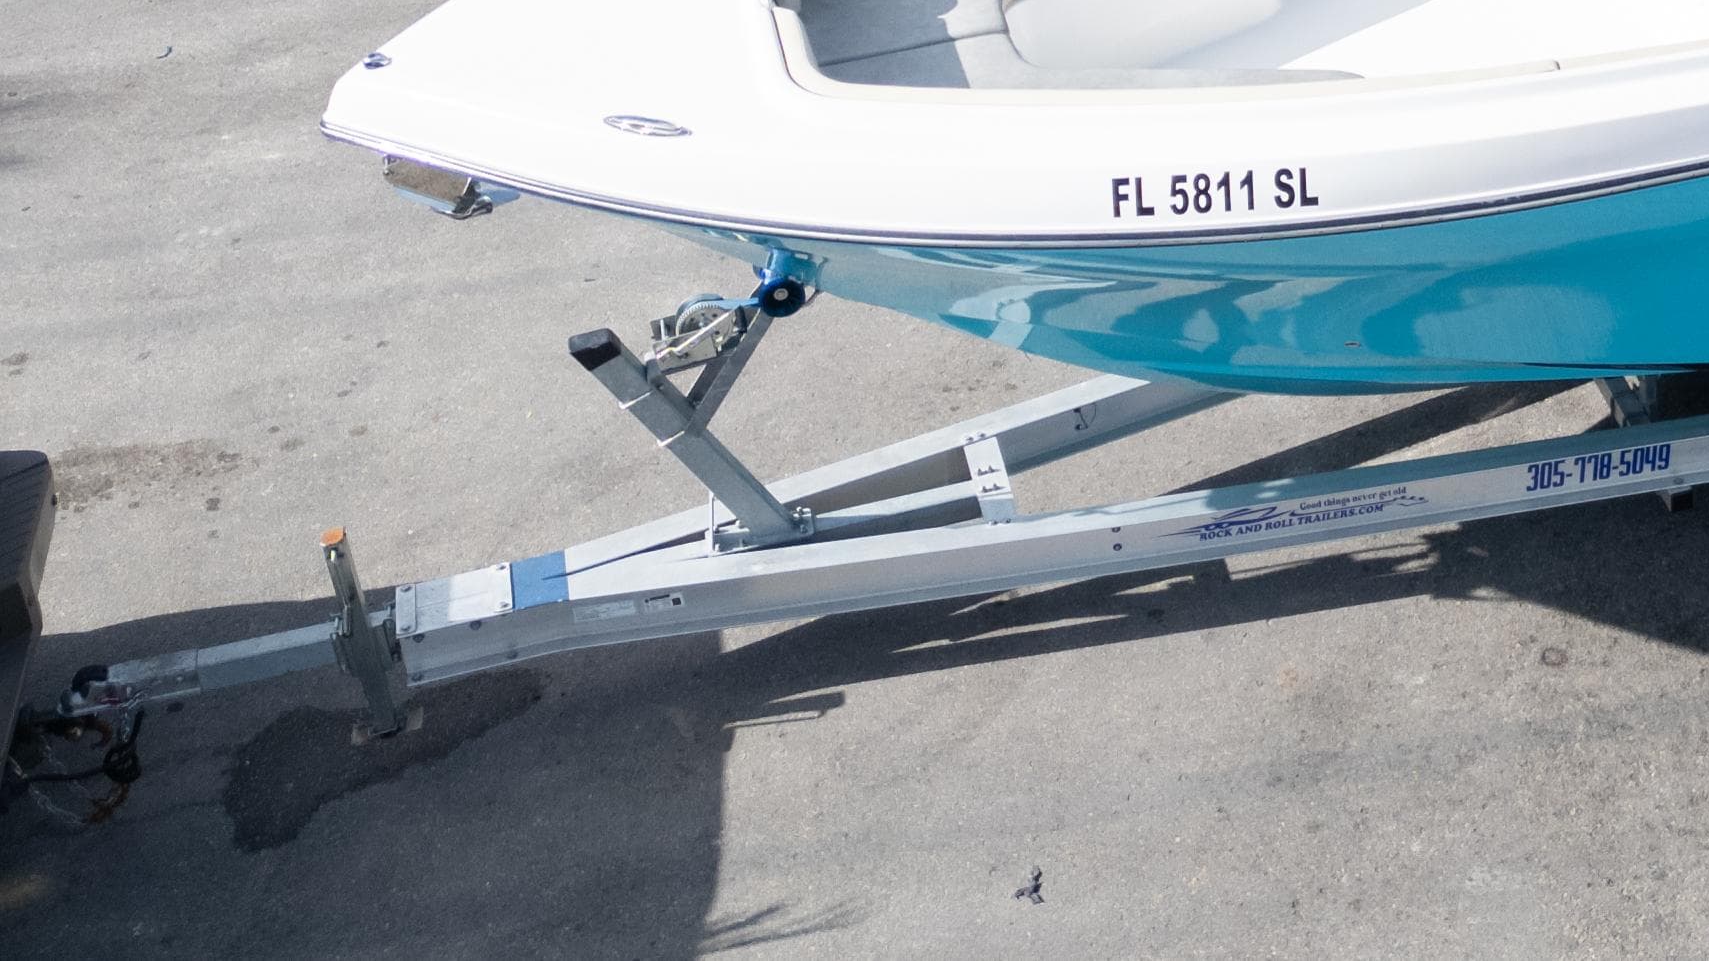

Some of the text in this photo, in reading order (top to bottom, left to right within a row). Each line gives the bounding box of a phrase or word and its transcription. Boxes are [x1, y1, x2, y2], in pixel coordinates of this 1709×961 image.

[1111, 167, 1319, 218] FL 5811 SL
[1526, 443, 1671, 492] 305-778-5049
[1300, 486, 1407, 511] Good things never get old
[1200, 503, 1384, 541] ROCK AND ROLL TRAILERS.COM
